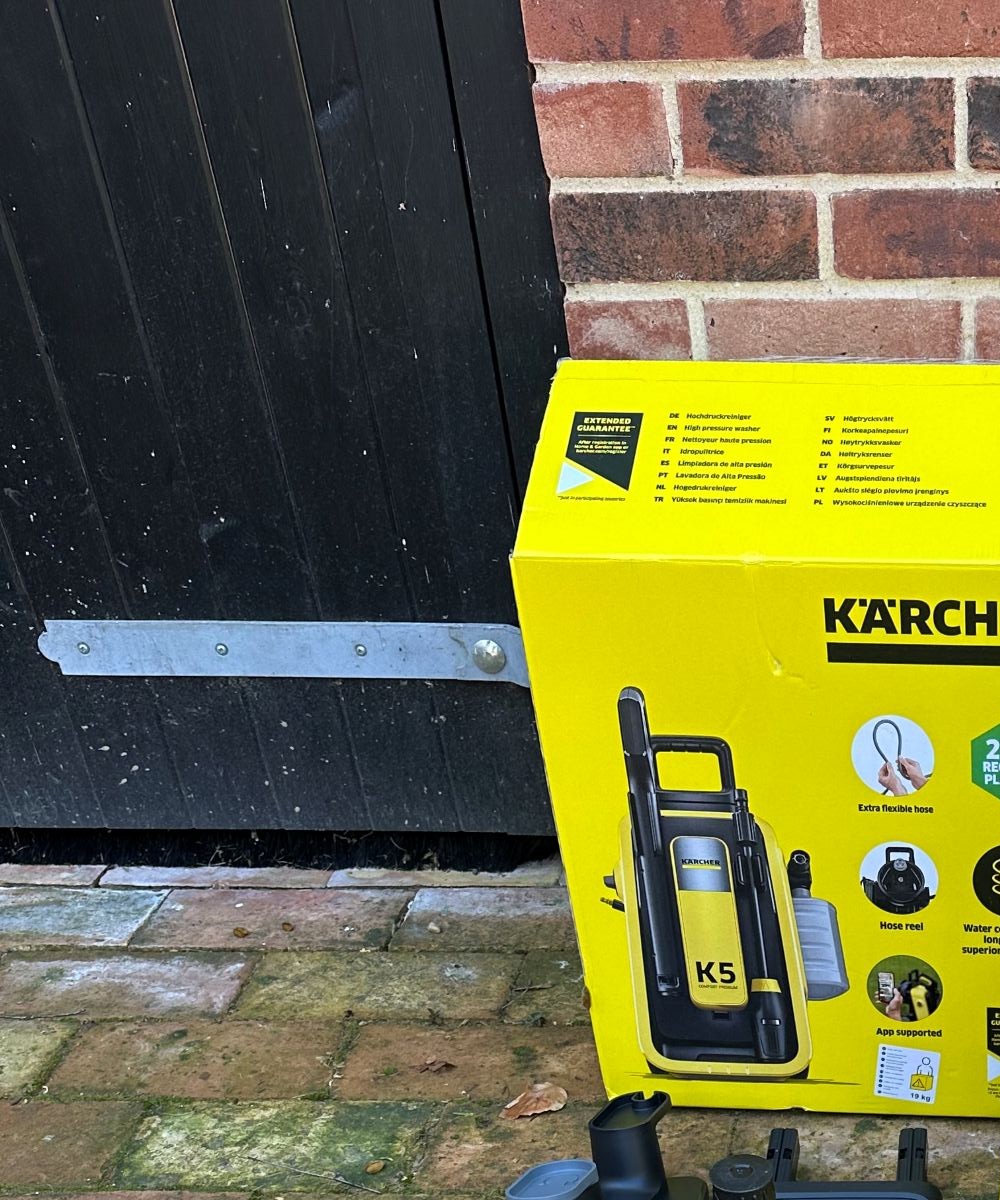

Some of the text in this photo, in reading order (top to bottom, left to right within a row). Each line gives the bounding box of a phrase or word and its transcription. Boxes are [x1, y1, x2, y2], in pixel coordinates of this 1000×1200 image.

[858, 804, 933, 813] Extra flexible hose
[681, 858, 720, 866] KÄRCHER
[880, 921, 923, 931] Hose reel
[963, 924, 992, 933] Water
[962, 946, 1000, 955] superior
[696, 961, 736, 984] K5
[876, 1028, 894, 1036] App
